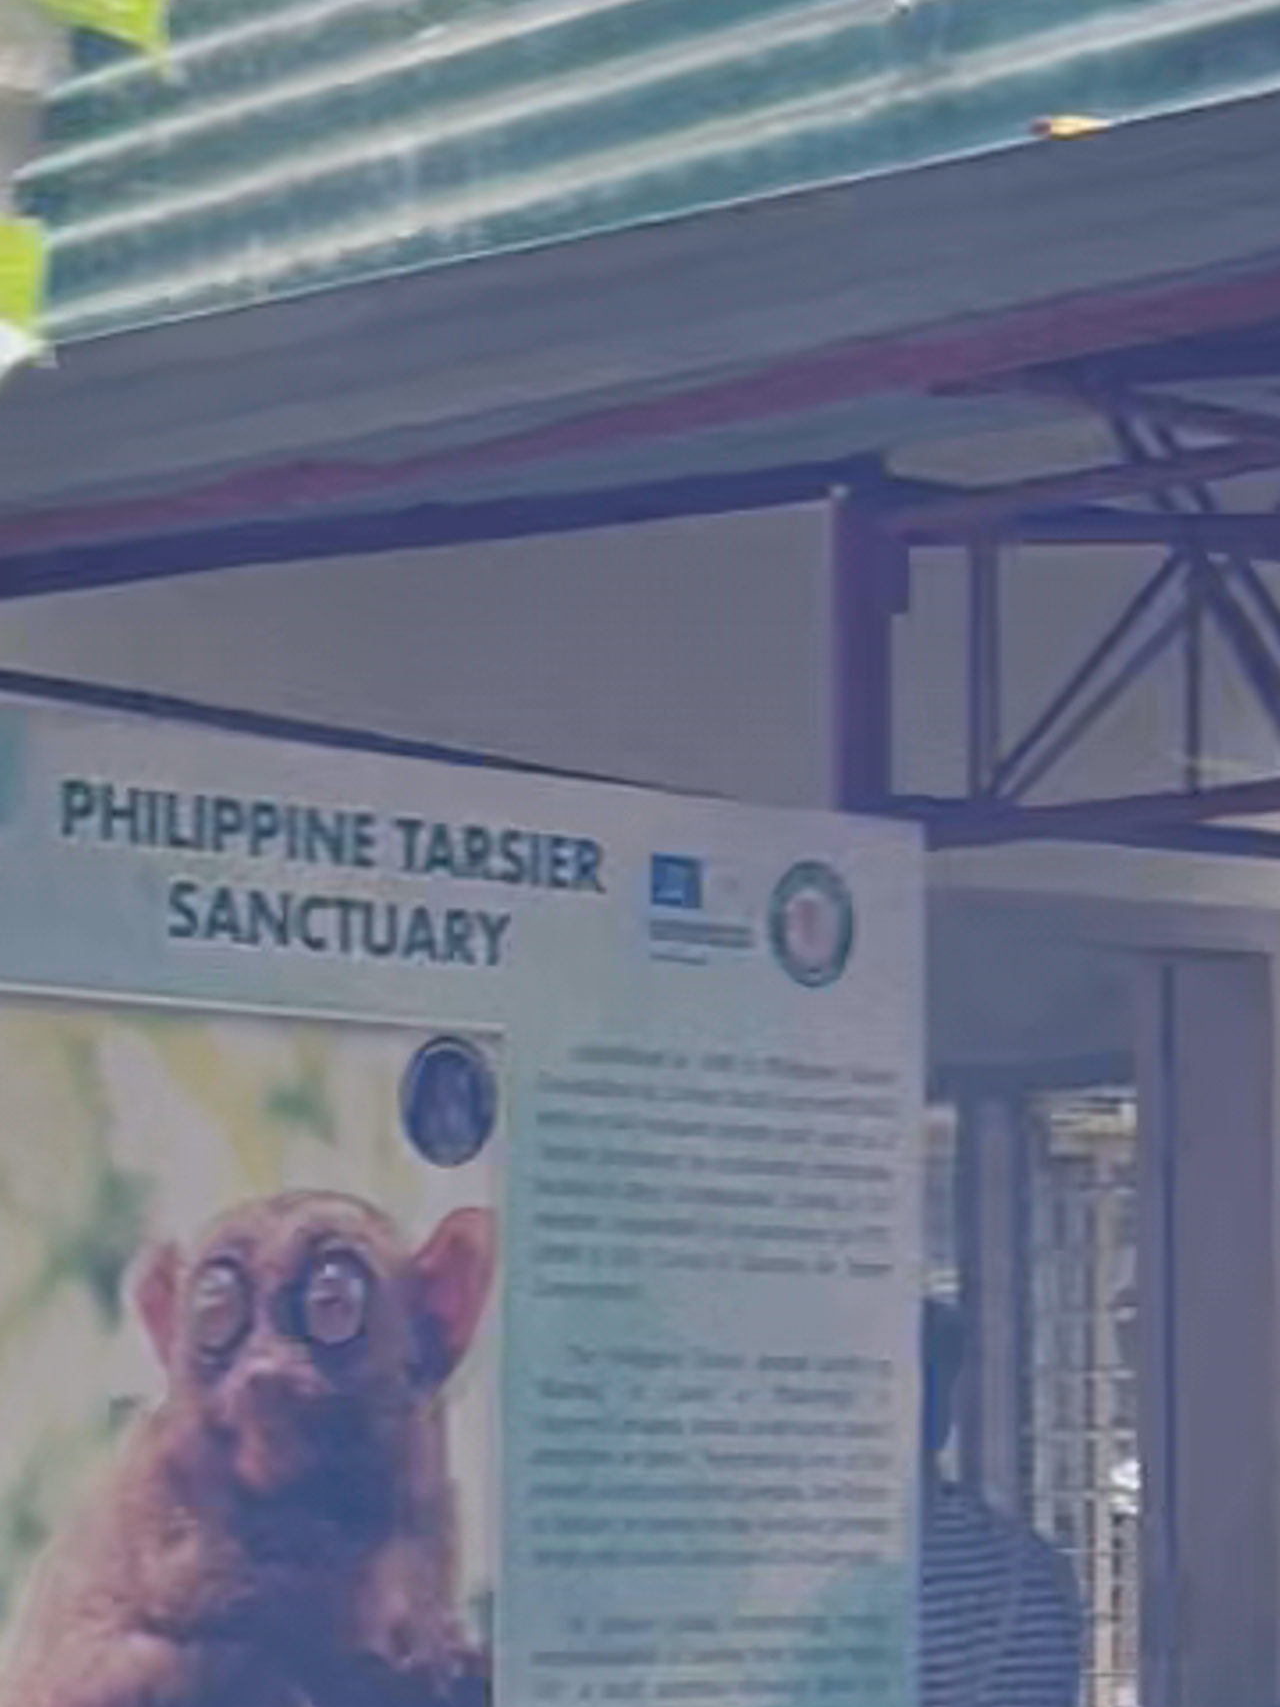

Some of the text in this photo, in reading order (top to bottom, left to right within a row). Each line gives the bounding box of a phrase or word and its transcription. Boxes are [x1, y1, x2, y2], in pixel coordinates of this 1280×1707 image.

[58, 779, 378, 869] PHILIPPINE
[393, 817, 607, 894] TARSIER
[167, 880, 511, 967] SANCTUARY
